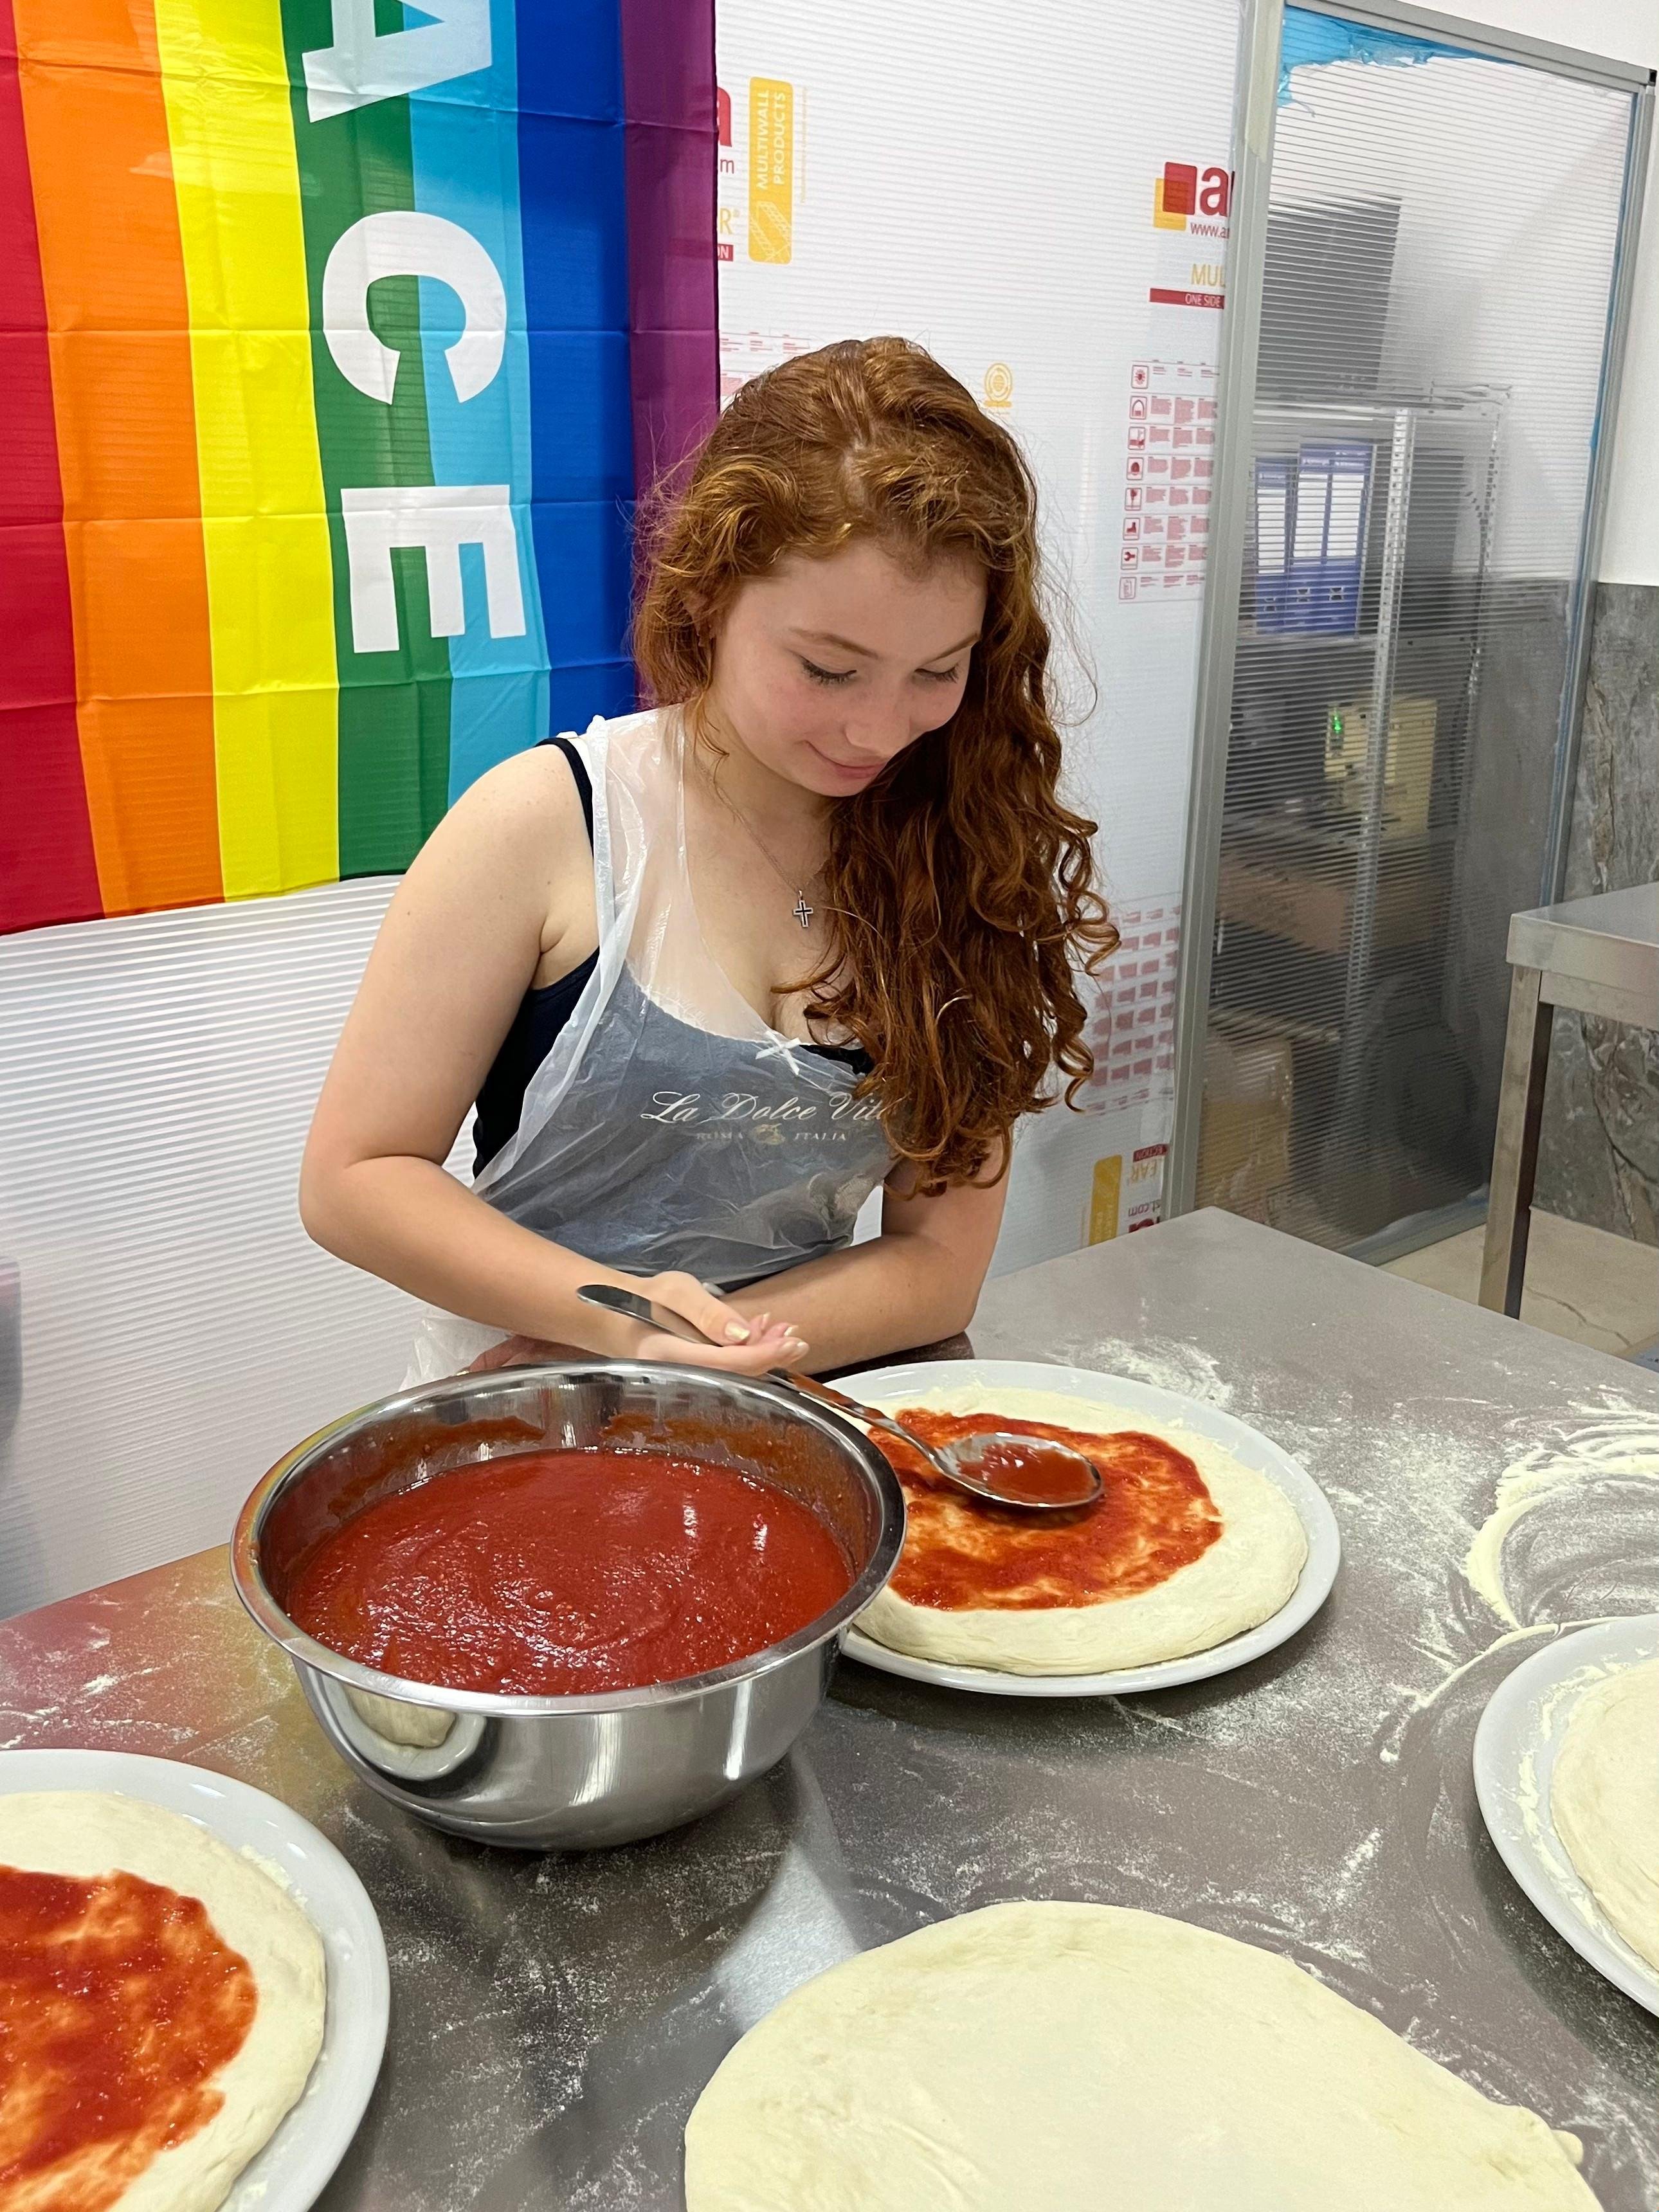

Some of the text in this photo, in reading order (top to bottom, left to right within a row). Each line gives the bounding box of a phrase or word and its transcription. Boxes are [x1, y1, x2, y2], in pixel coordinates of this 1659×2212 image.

[756, 89, 770, 190] MULTIWALL
[773, 91, 786, 185] PRODUCTS
[1200, 167, 1234, 217] a
[1185, 294, 1220, 307] ONE SIDE
[640, 1091, 700, 1123] La
[693, 1092, 818, 1127] Dolce
[793, 1132, 846, 1141] ITALIA
